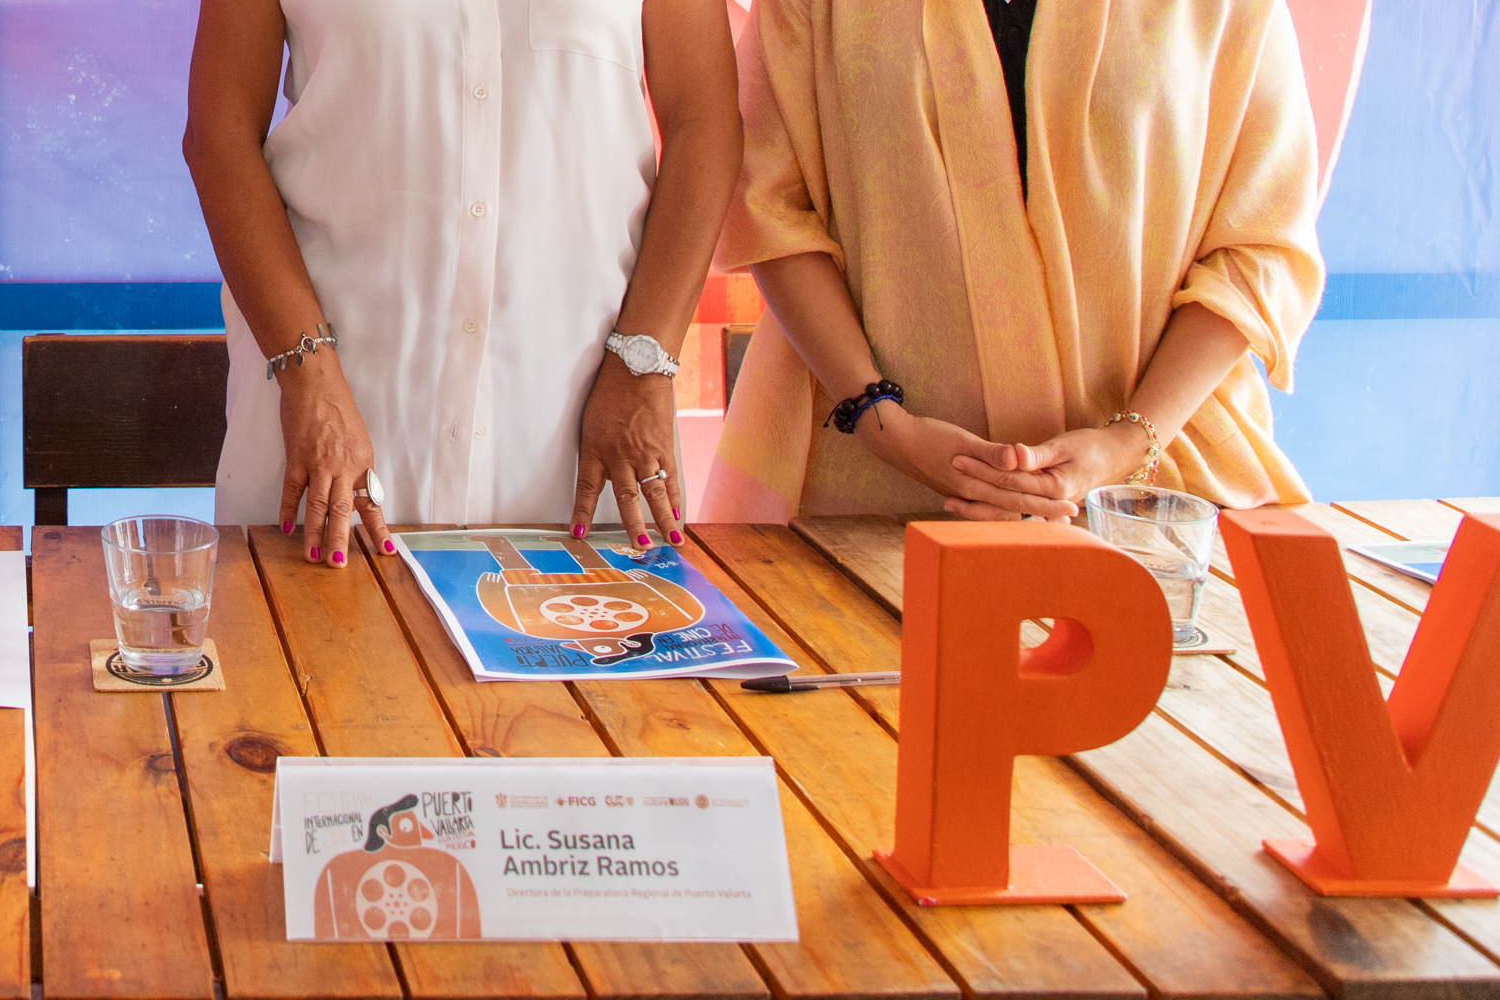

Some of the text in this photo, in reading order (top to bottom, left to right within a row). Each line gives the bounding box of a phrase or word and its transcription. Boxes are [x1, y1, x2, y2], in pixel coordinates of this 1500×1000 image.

[568, 796, 596, 806] FICG
[500, 829, 636, 850] Lic. Susana
[503, 855, 680, 876] Ambriz Ramos
[507, 888, 751, 899] Directora de la Preparatoria Regional de Puerto Vallarta
